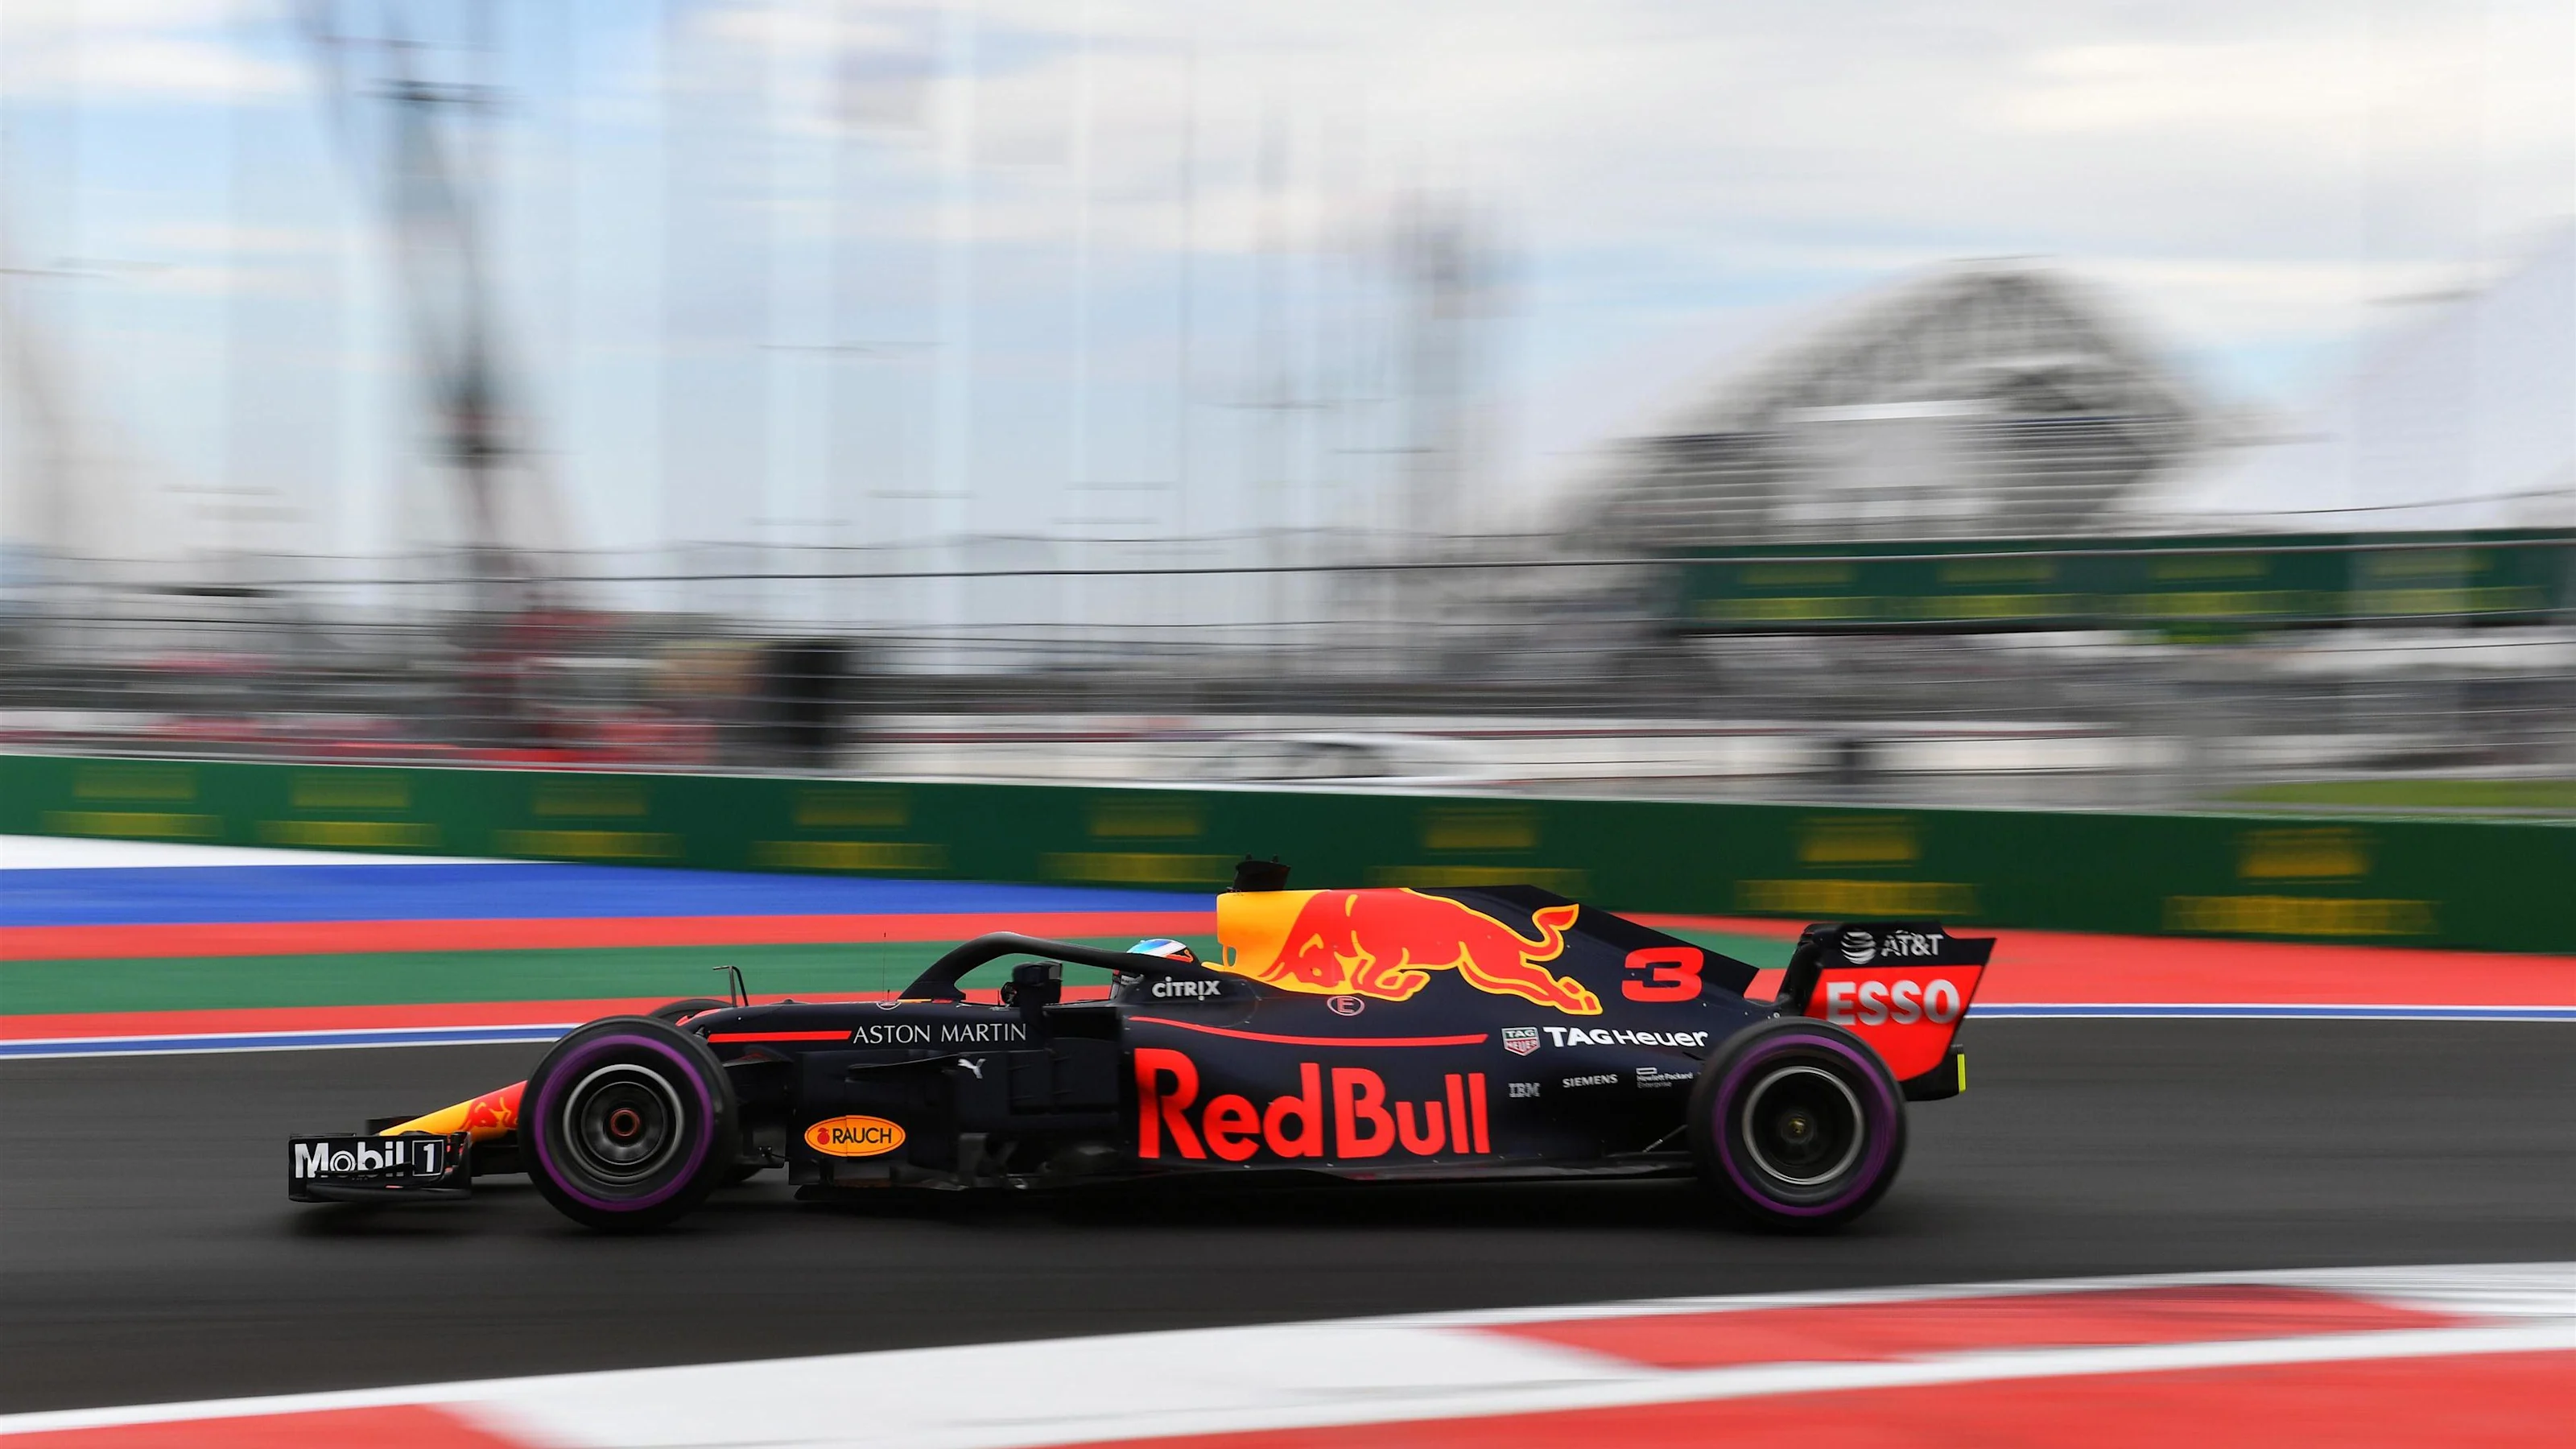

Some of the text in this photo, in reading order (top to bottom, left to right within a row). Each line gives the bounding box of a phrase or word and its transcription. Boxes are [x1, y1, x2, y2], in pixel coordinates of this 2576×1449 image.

[1880, 929, 1944, 957] AT&T
[1622, 947, 1704, 1002] 3
[1826, 979, 1960, 1026] ESSO
[853, 1023, 1026, 1044] ASTON MARTIN
[1505, 1030, 1536, 1038] TAG
[1508, 1082, 1541, 1098] IBM
[1562, 1074, 1618, 1088] SIEMENS
[832, 1128, 892, 1144] RAUCH
[295, 1141, 435, 1179] Mobil 1
